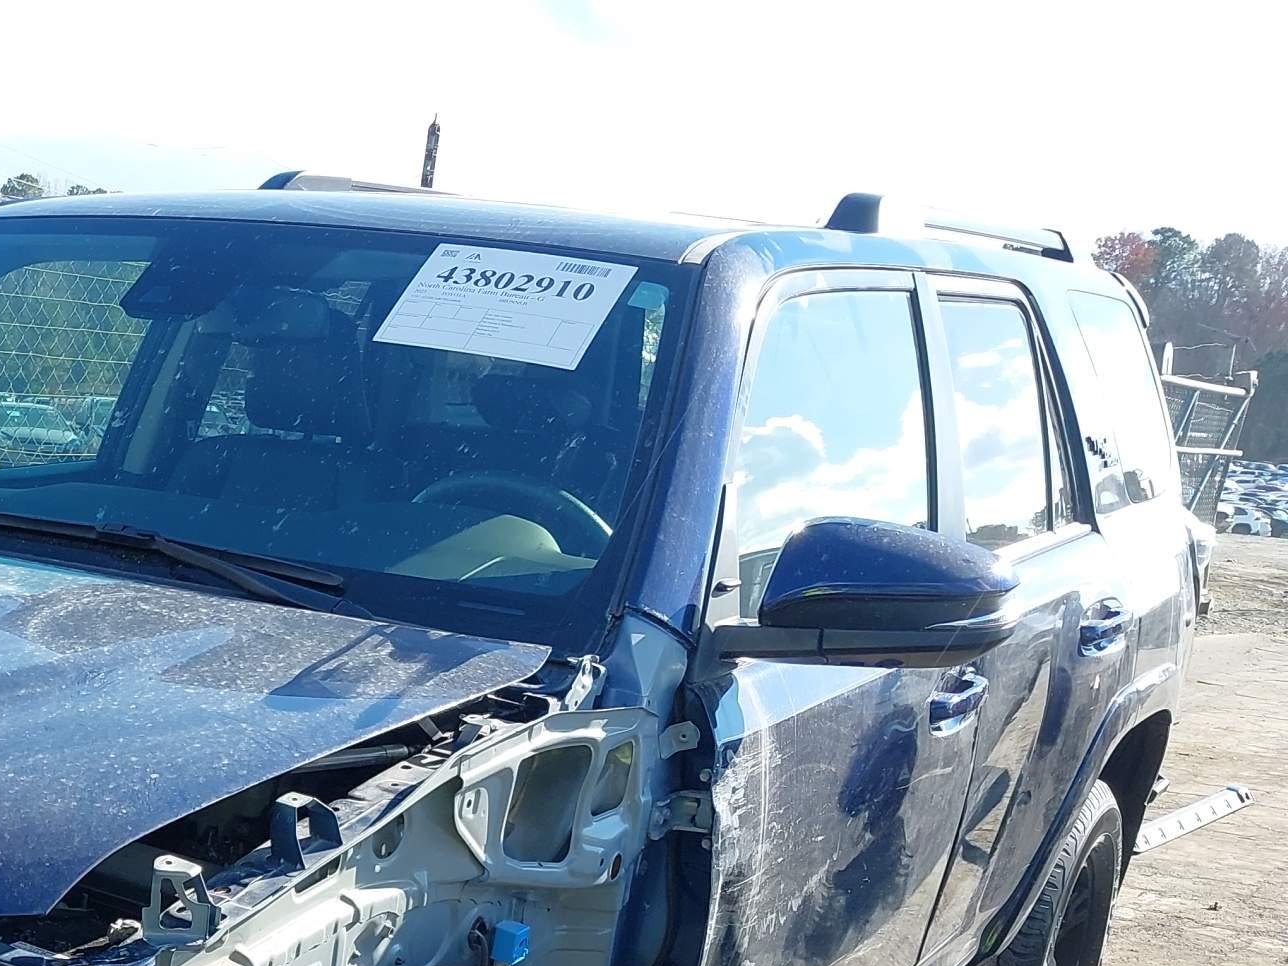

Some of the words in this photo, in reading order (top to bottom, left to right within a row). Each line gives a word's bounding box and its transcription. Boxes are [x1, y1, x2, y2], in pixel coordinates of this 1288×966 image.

[417, 281, 441, 290] North
[442, 282, 475, 294] Carolina
[436, 266, 595, 301] 43802910
